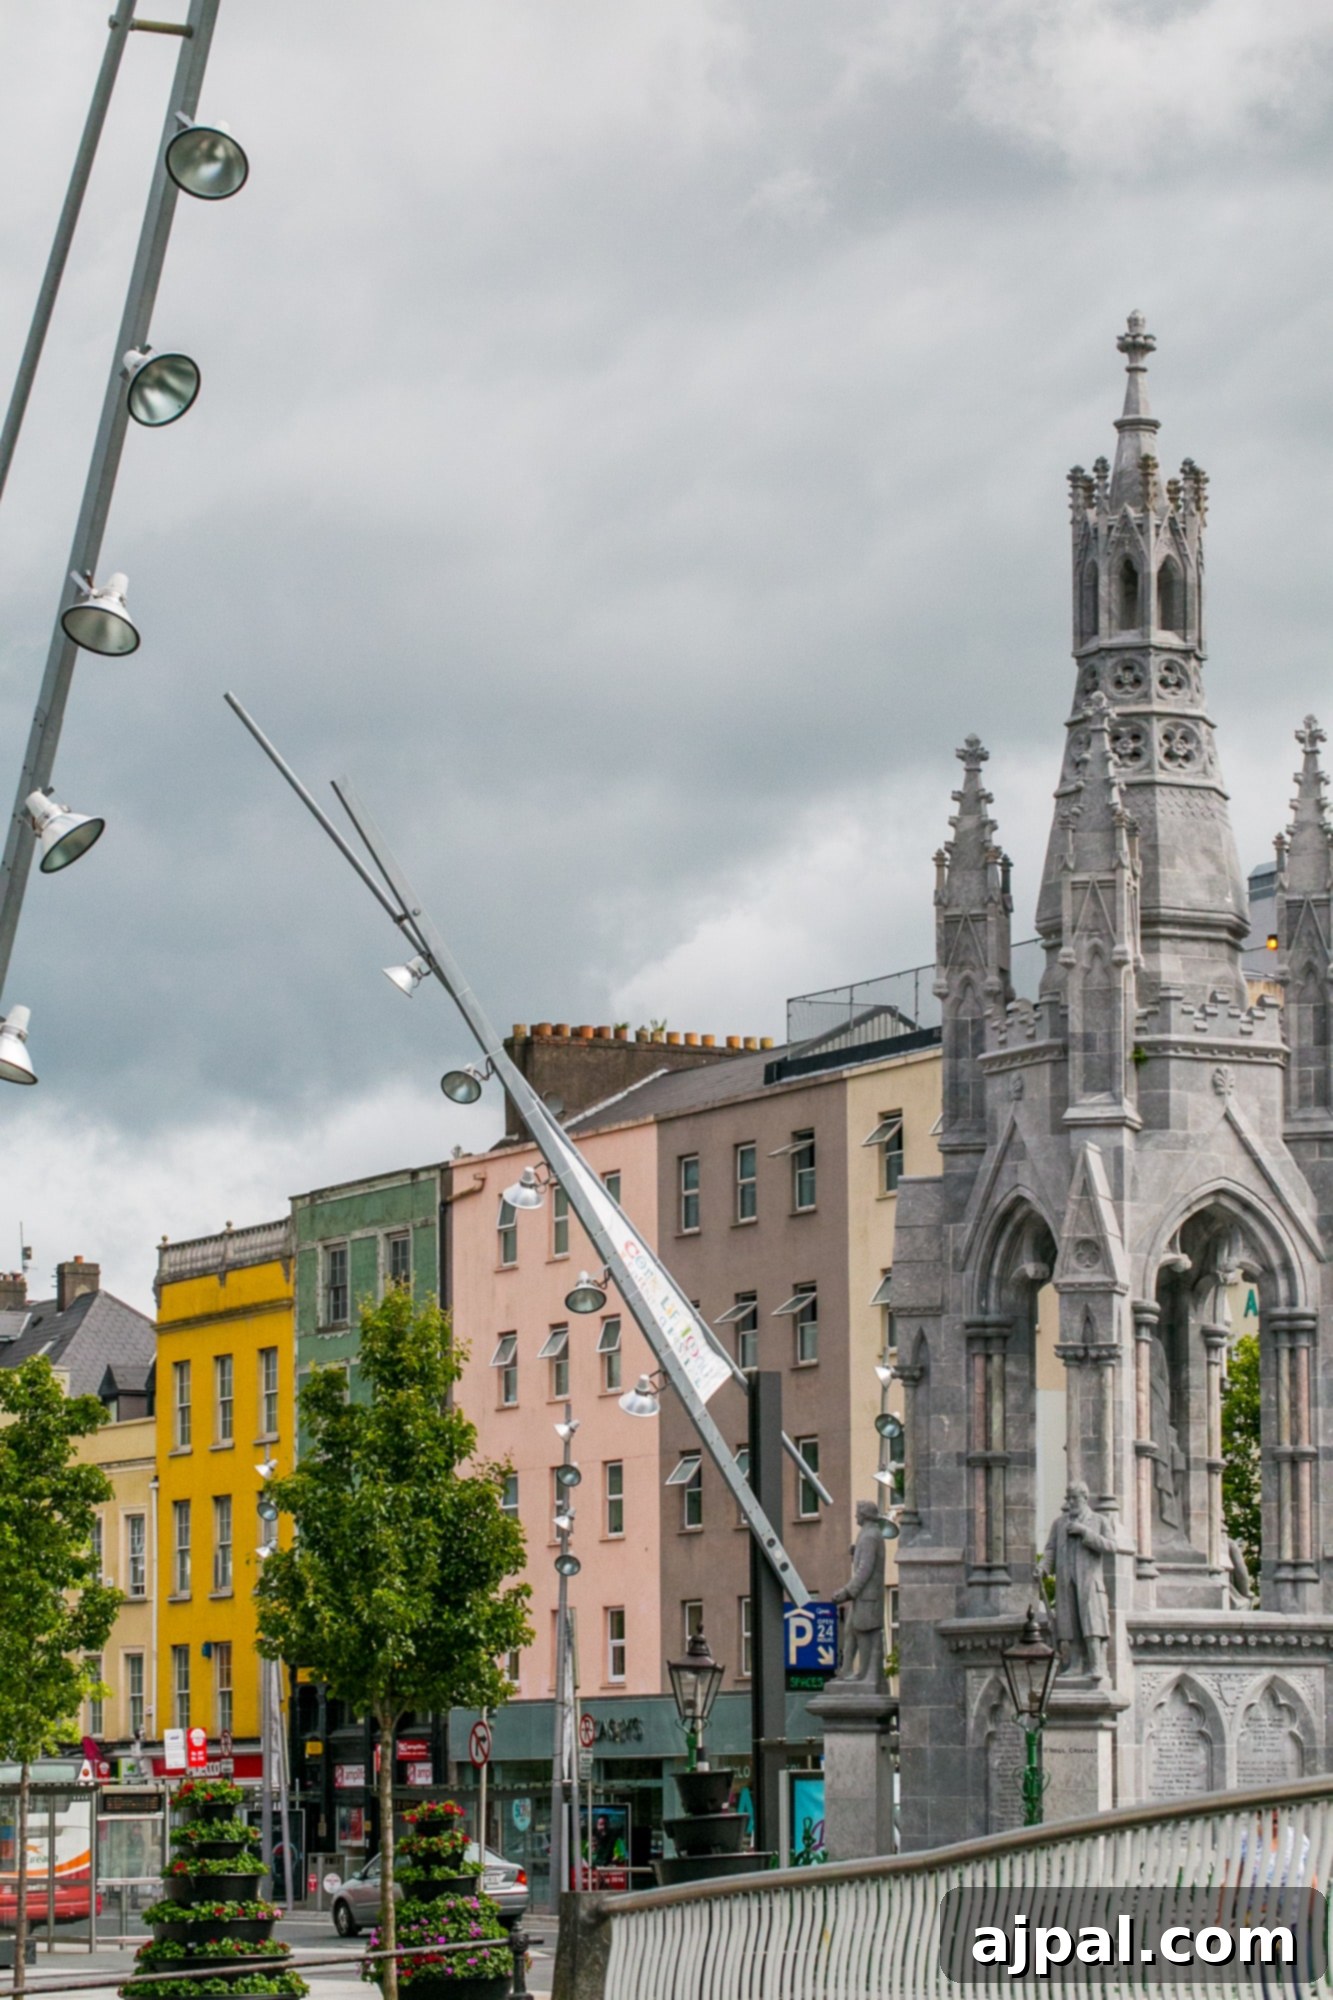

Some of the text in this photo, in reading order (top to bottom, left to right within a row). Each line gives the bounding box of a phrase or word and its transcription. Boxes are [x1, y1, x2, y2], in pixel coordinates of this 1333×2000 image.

[817, 1625, 834, 1637] 24
[789, 1617, 813, 1665] P
[789, 1676, 824, 1688] SPACES
